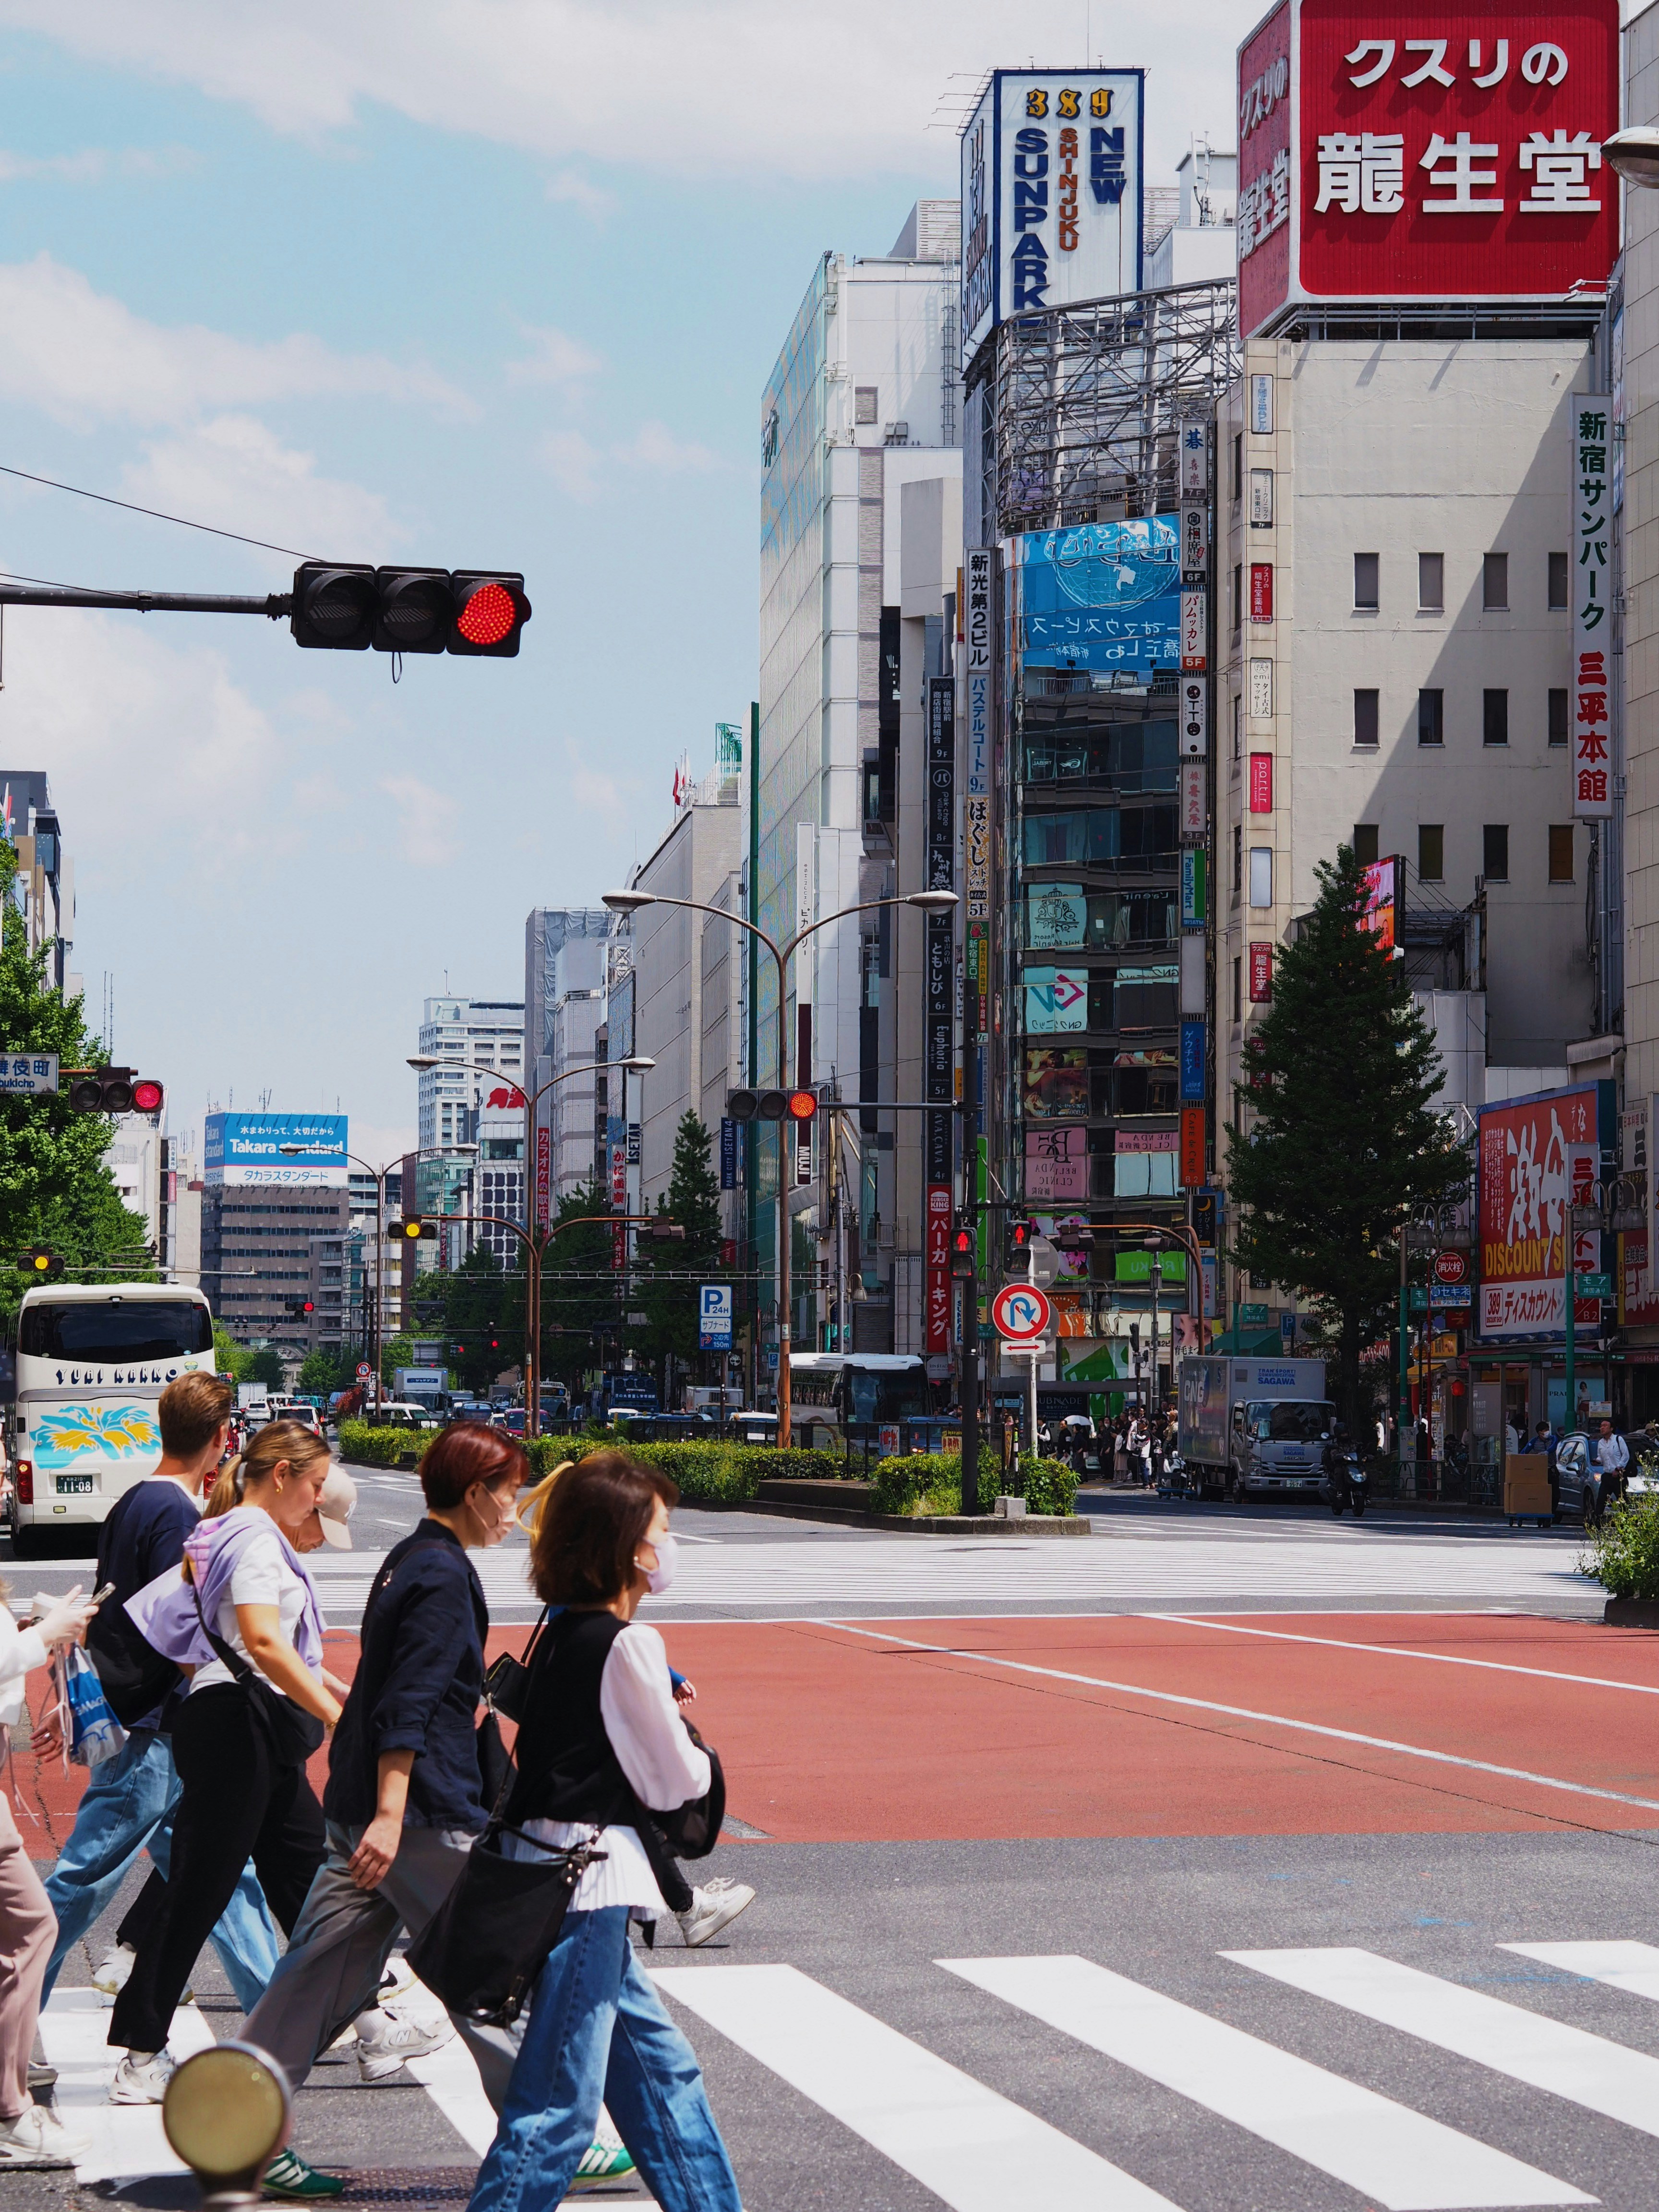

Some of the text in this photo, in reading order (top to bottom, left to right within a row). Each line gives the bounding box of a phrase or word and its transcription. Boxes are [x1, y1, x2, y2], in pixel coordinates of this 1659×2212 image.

[1344, 39, 1568, 88] クスリの
[1240, 57, 1287, 140] クスリの
[1090, 127, 1127, 204] NEW
[1314, 129, 1601, 213] 龍生堂
[1059, 128, 1080, 252] SHINJUKU
[1011, 128, 1051, 310] SUNPARK
[1238, 148, 1289, 263] 龍生堂
[1185, 428, 1204, 450] 碁
[1579, 411, 1607, 631] 新宿サンパーク
[1187, 526, 1201, 567] 相席屋
[1187, 573, 1201, 582] 6F
[1254, 572, 1262, 614] 龍生堂薬局
[970, 554, 989, 666] 新光第2ビル
[1186, 596, 1198, 652] パムッカレ
[1186, 658, 1202, 666] 5F
[933, 691, 941, 744] 商店街振興組合
[943, 691, 951, 721] 新宿駅前
[972, 678, 986, 771] パステルコート
[1577, 652, 1608, 803] 三平本館
[936, 749, 948, 757] 9F
[970, 777, 985, 792] 9F
[969, 801, 987, 866] ほぐし
[1183, 857, 1194, 909] FamilyMart
[936, 918, 947, 926] 7F
[969, 903, 987, 916] 5F
[801, 909, 810, 955] ピカリー
[931, 942, 943, 995] ともしび
[1255, 954, 1267, 991] 龍生堂
[935, 1001, 946, 1010] 6F
[933, 1025, 950, 1070] Euphoria
[977, 1034, 987, 1042] 7F
[1185, 1030, 1194, 1074] ゲウチャイ
[935, 1086, 946, 1095] 5F
[205, 1125, 219, 1142] Takara
[240, 1125, 334, 1136] 水まわりって、大切だから
[724, 1127, 733, 1155] ISETAN
[1618, 1127, 1623, 1162] 6F
[205, 1138, 224, 1158] standard
[230, 1139, 276, 1154] Takara
[538, 1130, 549, 1180] カラオケ
[798, 1146, 810, 1176] MUJI
[244, 1169, 328, 1182] タカラスタンダード
[613, 1151, 625, 1203] かに道楽
[935, 1171, 946, 1179] 4F
[1438, 1261, 1462, 1273] 消火栓
[1485, 1237, 1550, 1276] DISCOUNT
[931, 1217, 949, 1336] バーガーキング
[1583, 1276, 1606, 1285] モア
[705, 1290, 723, 1313] P
[1441, 1286, 1470, 1297] セキネ
[1488, 1293, 1501, 1315] 389
[703, 1321, 729, 1330] サブナード
[1583, 1310, 1598, 1320] B2
[56, 1366, 179, 1384] YUAI KANKO
[1258, 1377, 1296, 1385] SAGAWA
[1037, 1396, 1083, 1405] UBNADE
[1184, 1380, 1204, 1403] CNG
[64, 1481, 91, 1492] 11-08
